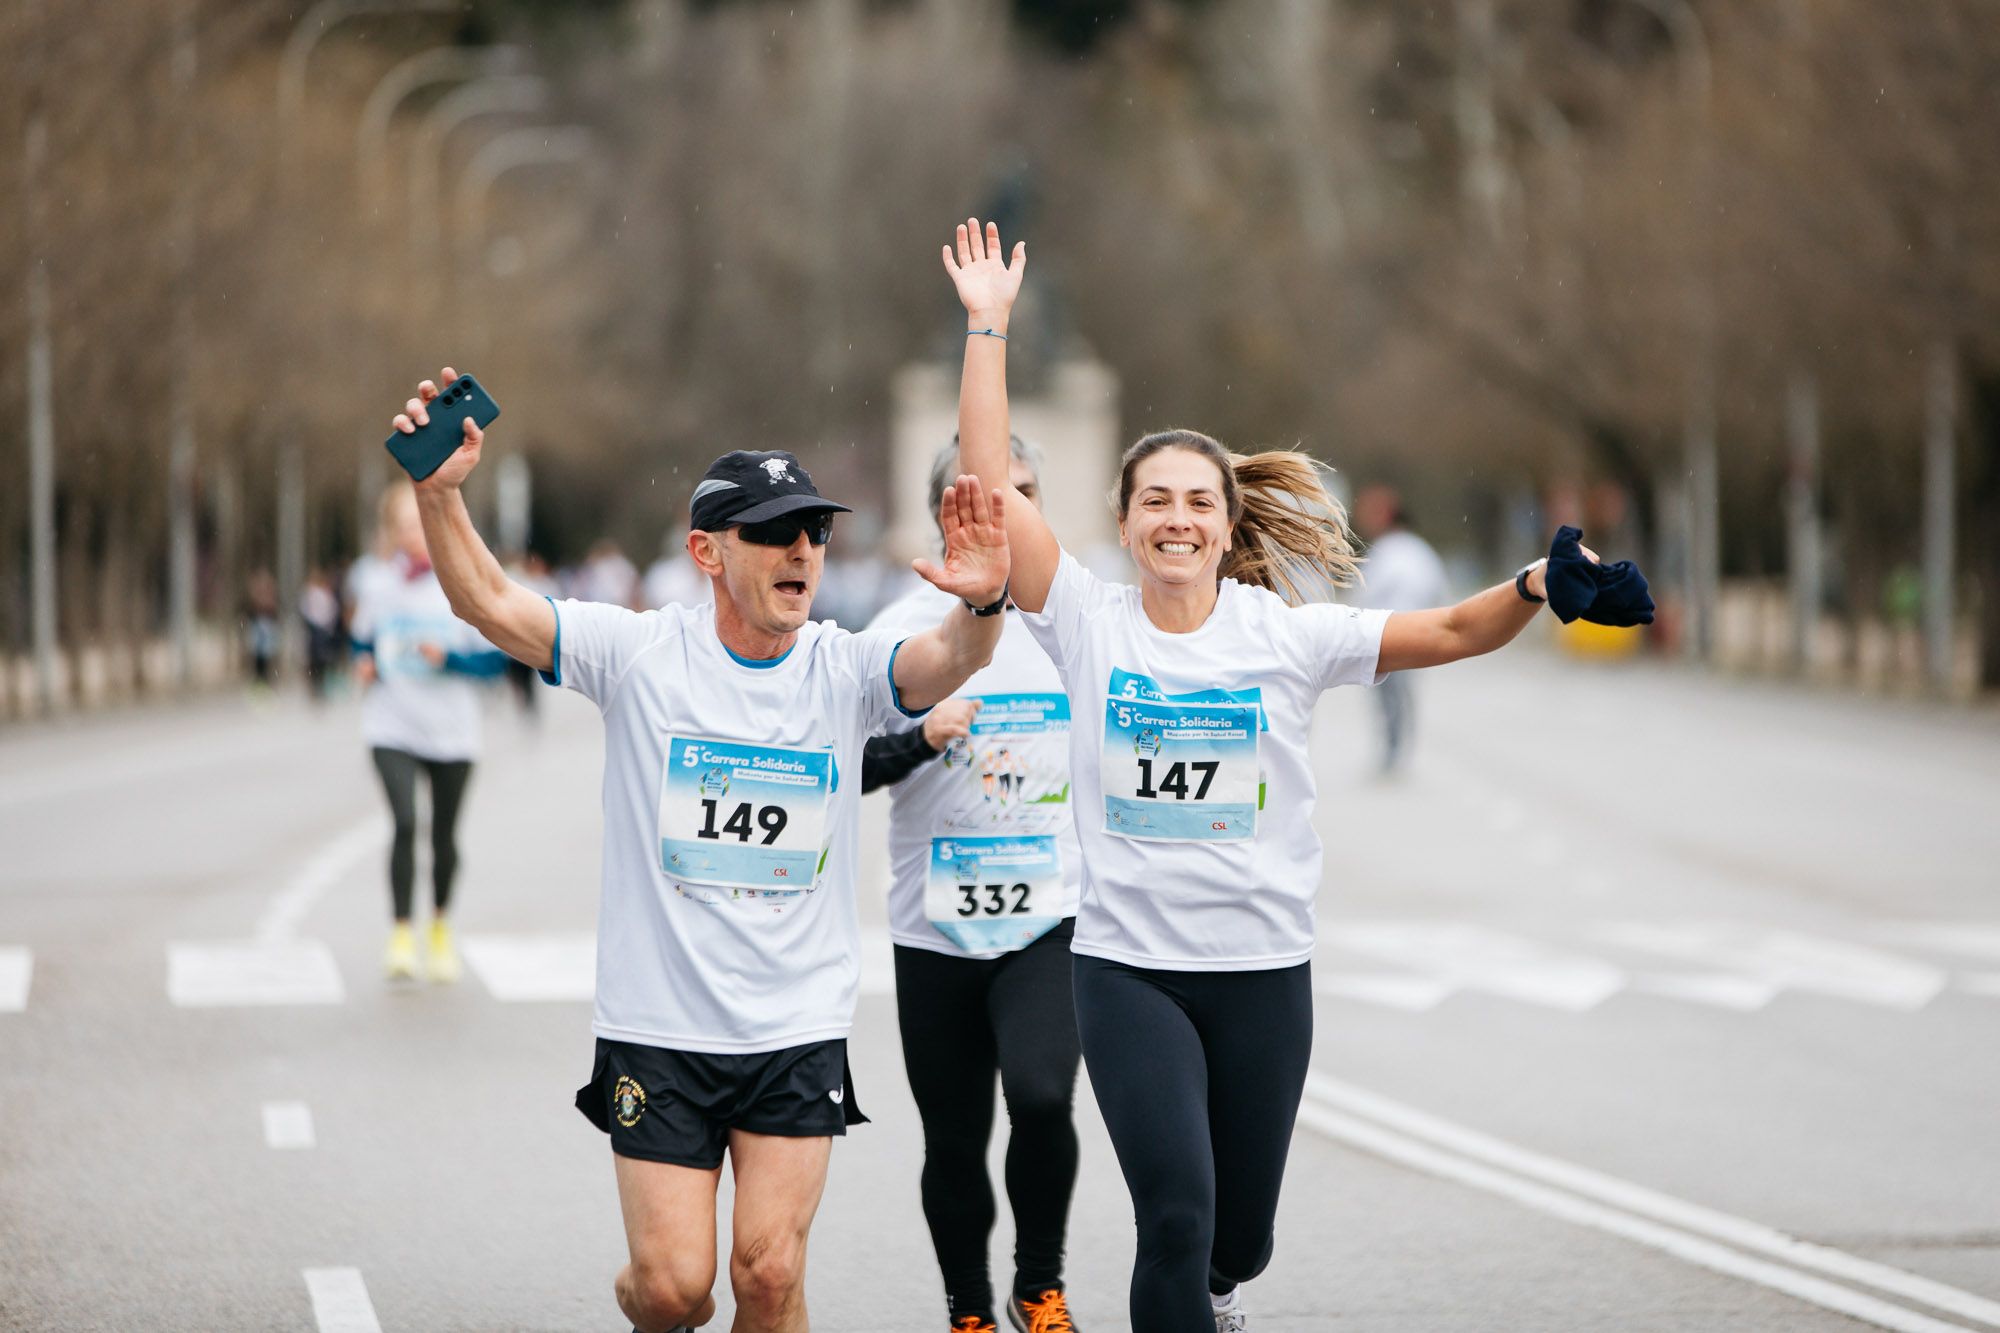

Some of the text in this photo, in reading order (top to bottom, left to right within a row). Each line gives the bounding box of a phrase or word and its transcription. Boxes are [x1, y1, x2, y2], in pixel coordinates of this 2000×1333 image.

[1134, 713, 1177, 728] Carrera
[1179, 717, 1232, 728] Solidaria
[702, 751, 750, 768] Carrera
[752, 756, 806, 773] Solidaria
[1136, 758, 1220, 801] 147
[697, 799, 788, 846] 149
[1212, 821, 1228, 831] CSL
[955, 845, 994, 856] Carrera
[773, 868, 789, 877] CSL
[957, 881, 1032, 917] 332
